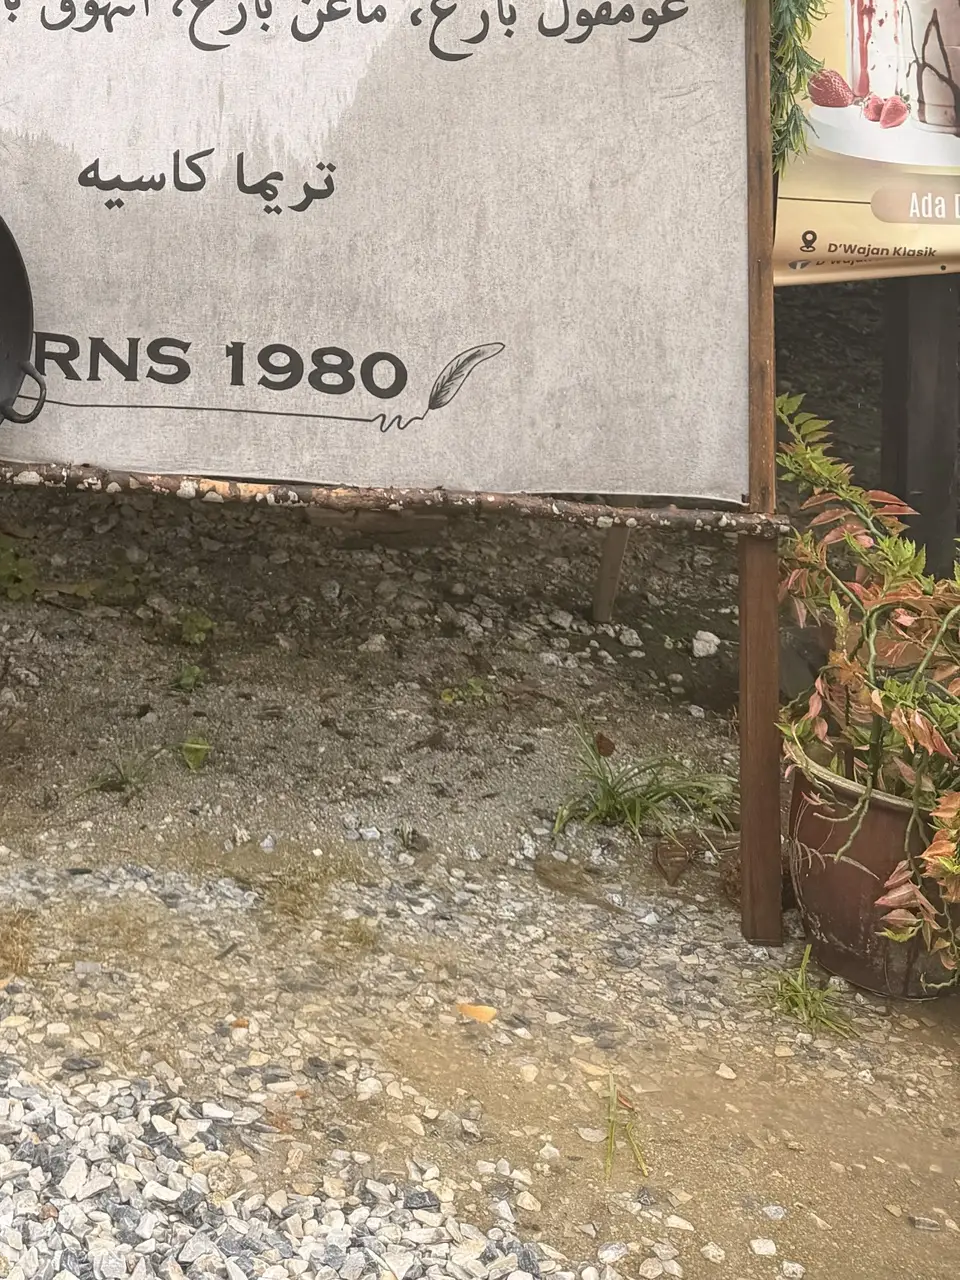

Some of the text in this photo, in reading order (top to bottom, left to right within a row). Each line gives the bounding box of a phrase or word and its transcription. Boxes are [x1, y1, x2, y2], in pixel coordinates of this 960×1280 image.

[77, 147, 337, 216] تريما كاسيه
[909, 192, 946, 219] Ada
[892, 246, 937, 258] Klasik
[225, 340, 408, 399] 1980
